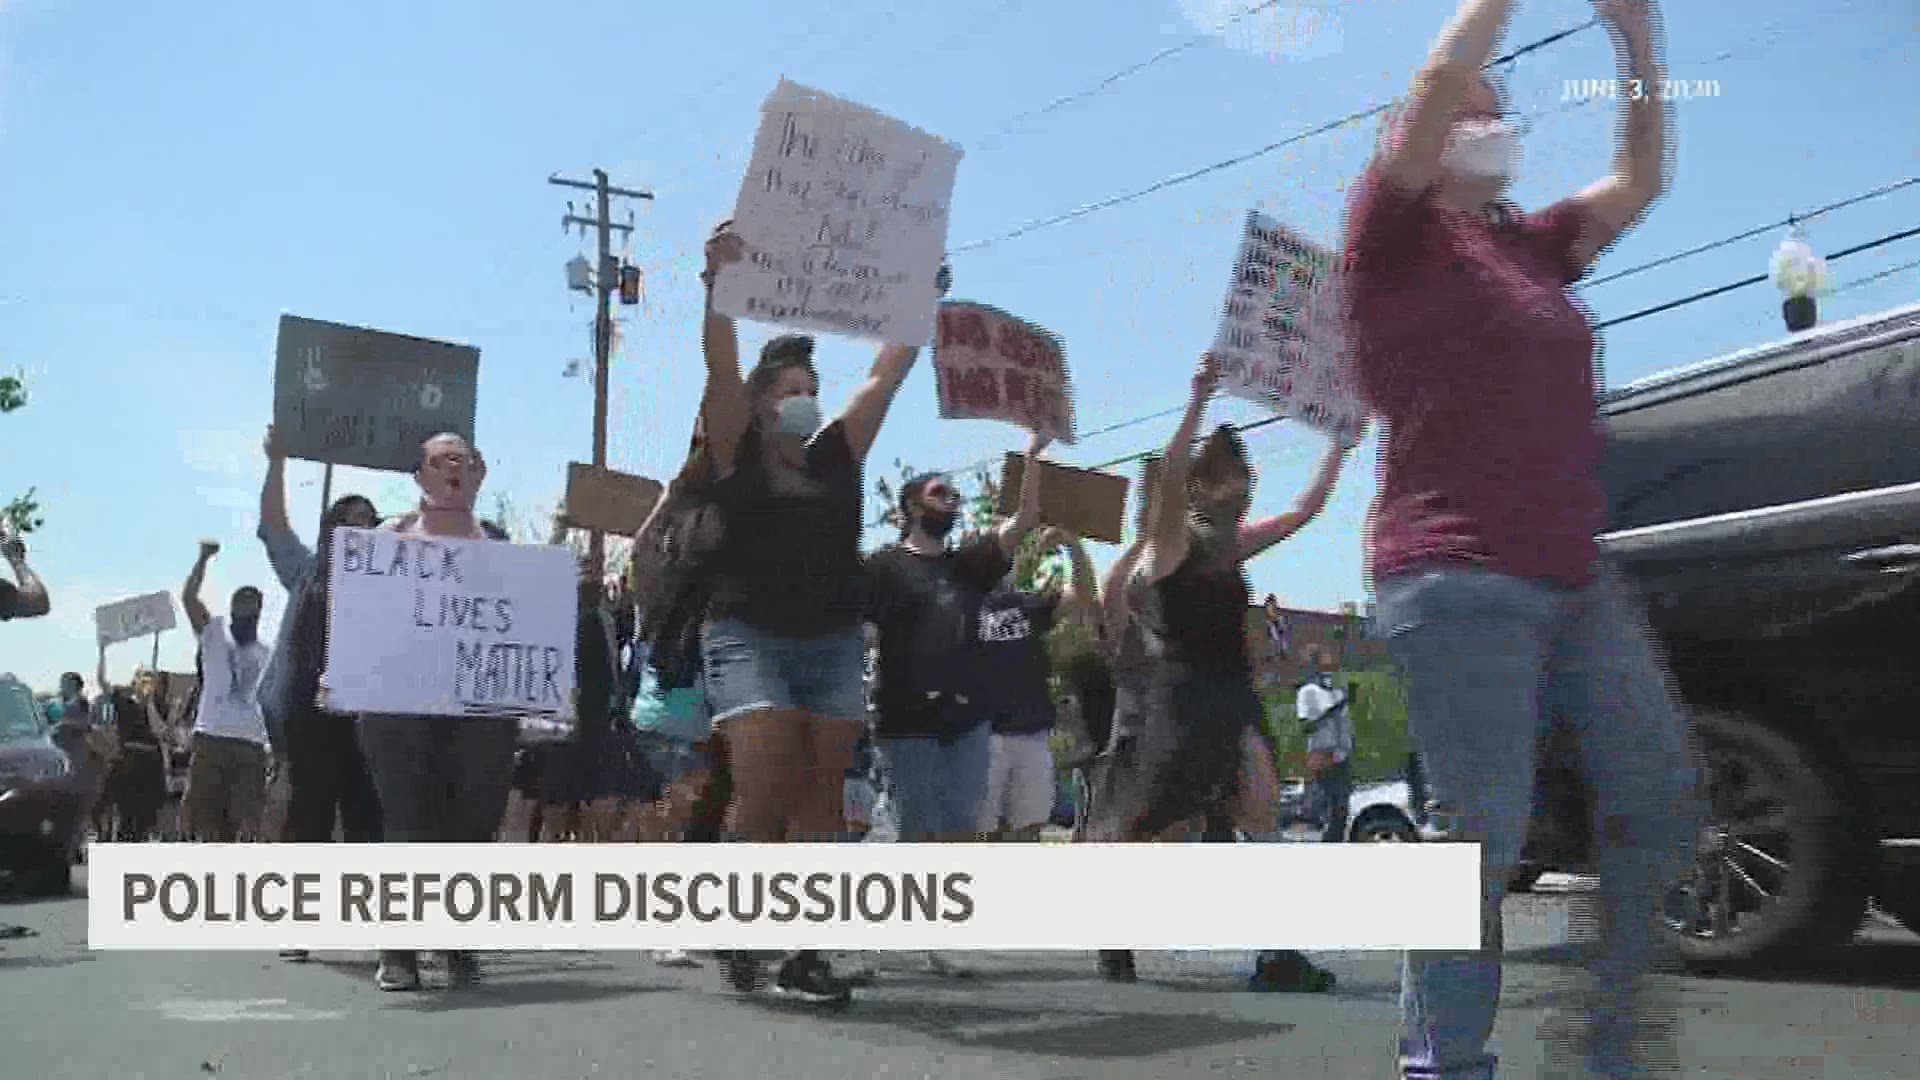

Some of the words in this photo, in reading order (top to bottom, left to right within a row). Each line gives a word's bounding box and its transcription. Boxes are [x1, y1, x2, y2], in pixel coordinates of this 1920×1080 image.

[342, 529, 464, 584] BLACK
[414, 589, 514, 633] LIVES
[455, 640, 563, 702] MATTER
